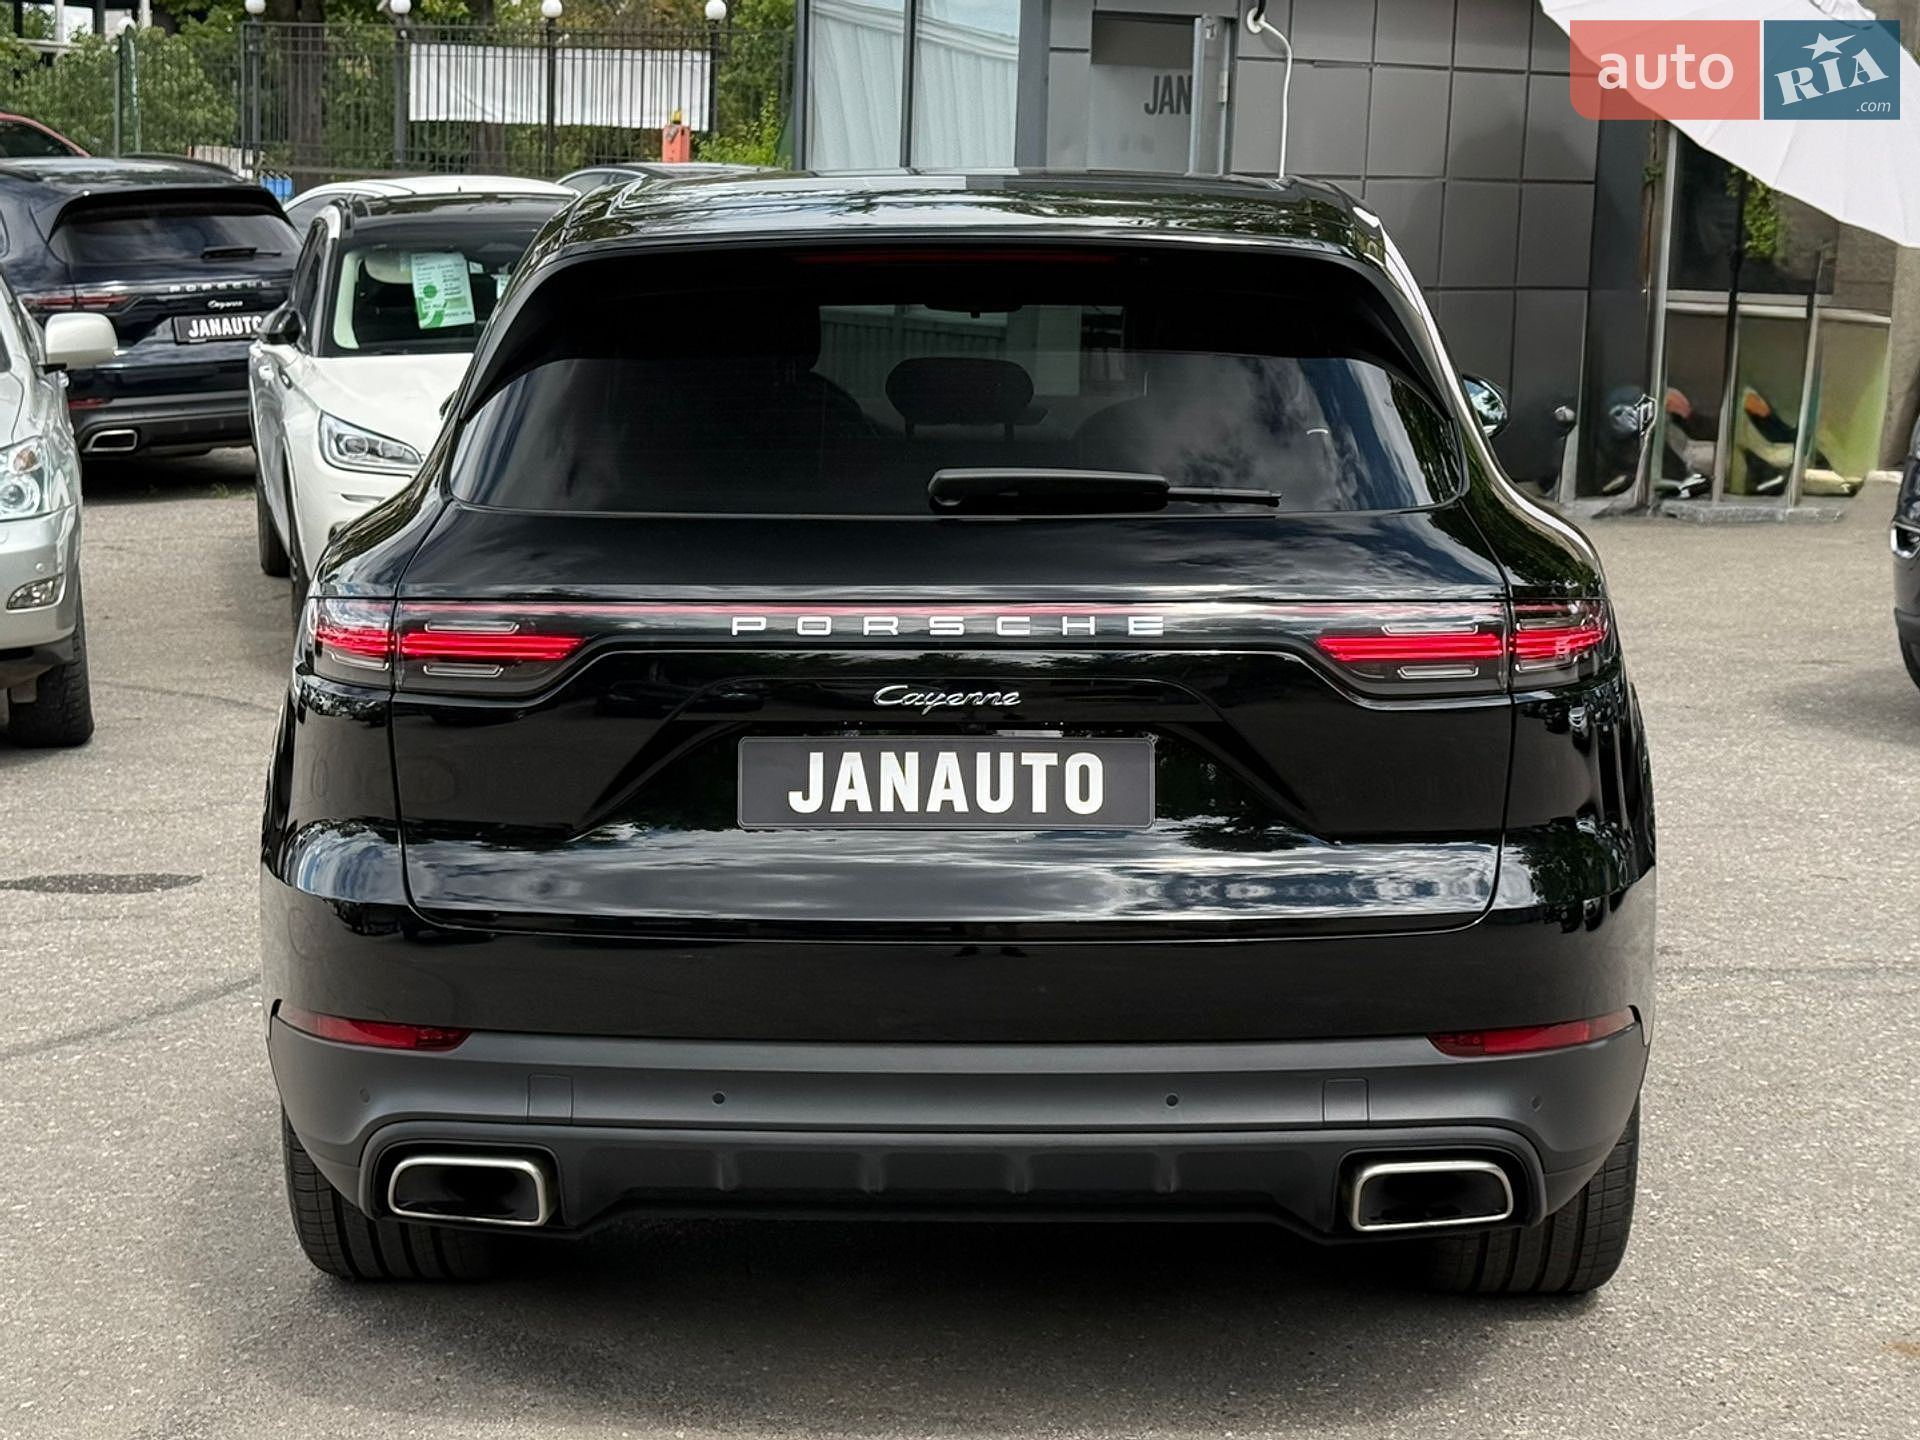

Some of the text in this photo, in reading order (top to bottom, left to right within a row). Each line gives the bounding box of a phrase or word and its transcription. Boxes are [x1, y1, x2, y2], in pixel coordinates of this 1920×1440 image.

[731, 615, 1165, 637] PORSCHE
[872, 685, 1022, 716] Cayenne
[787, 750, 1104, 816] JANAUTO
